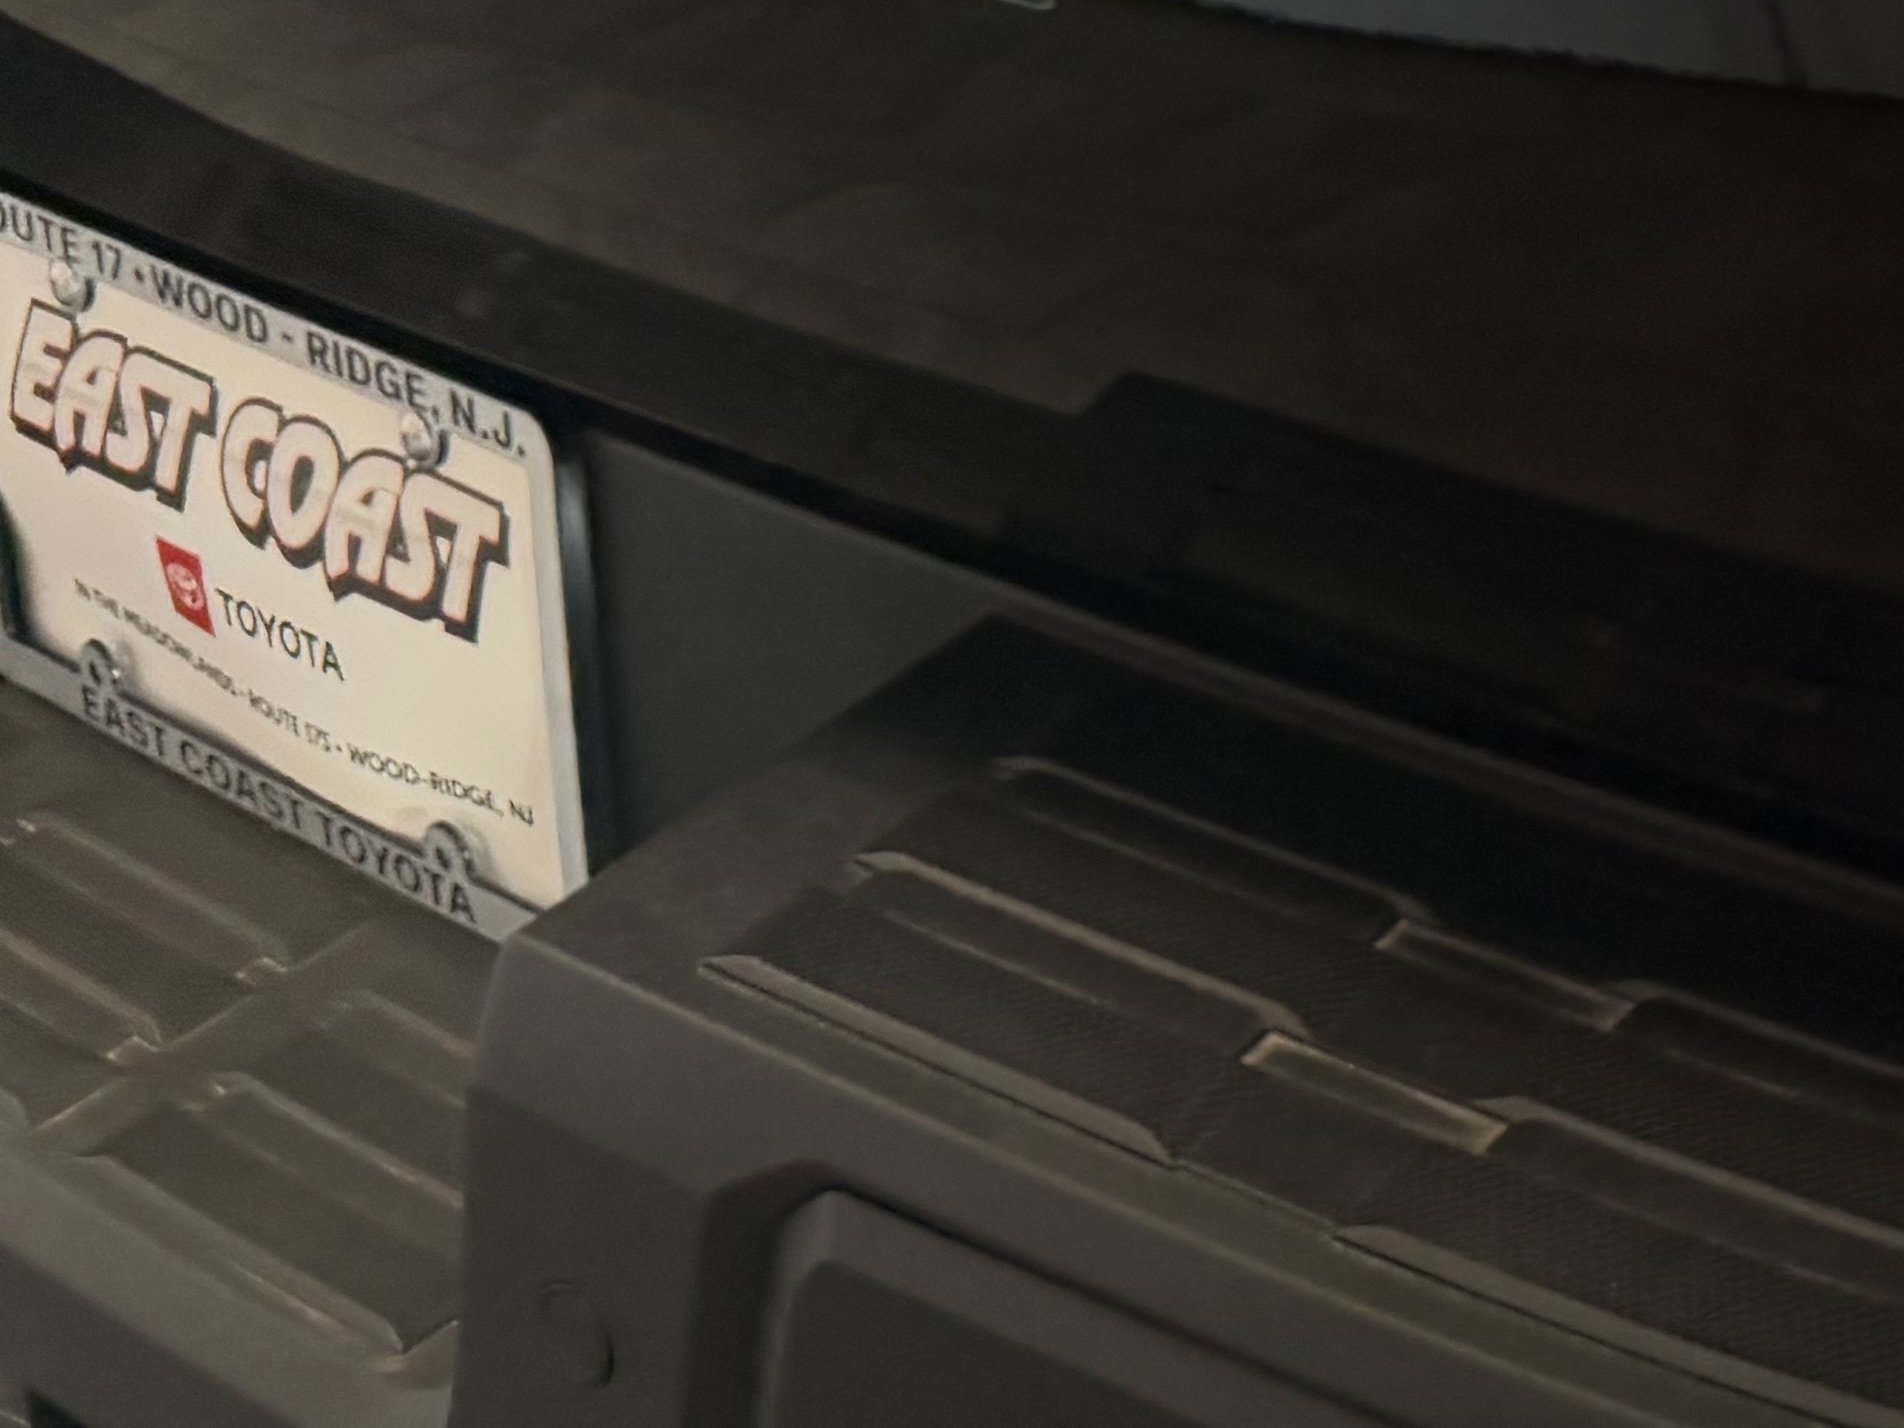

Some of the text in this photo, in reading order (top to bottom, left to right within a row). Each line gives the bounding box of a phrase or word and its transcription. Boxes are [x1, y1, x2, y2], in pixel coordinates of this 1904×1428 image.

[92, 240, 122, 280] 17
[151, 263, 268, 343] WOOD
[10, 298, 510, 644] EAST COAST
[213, 587, 345, 682] TOYOTA
[81, 684, 477, 924] EAST COAST TOYOTA
[509, 798, 535, 828] NJ
